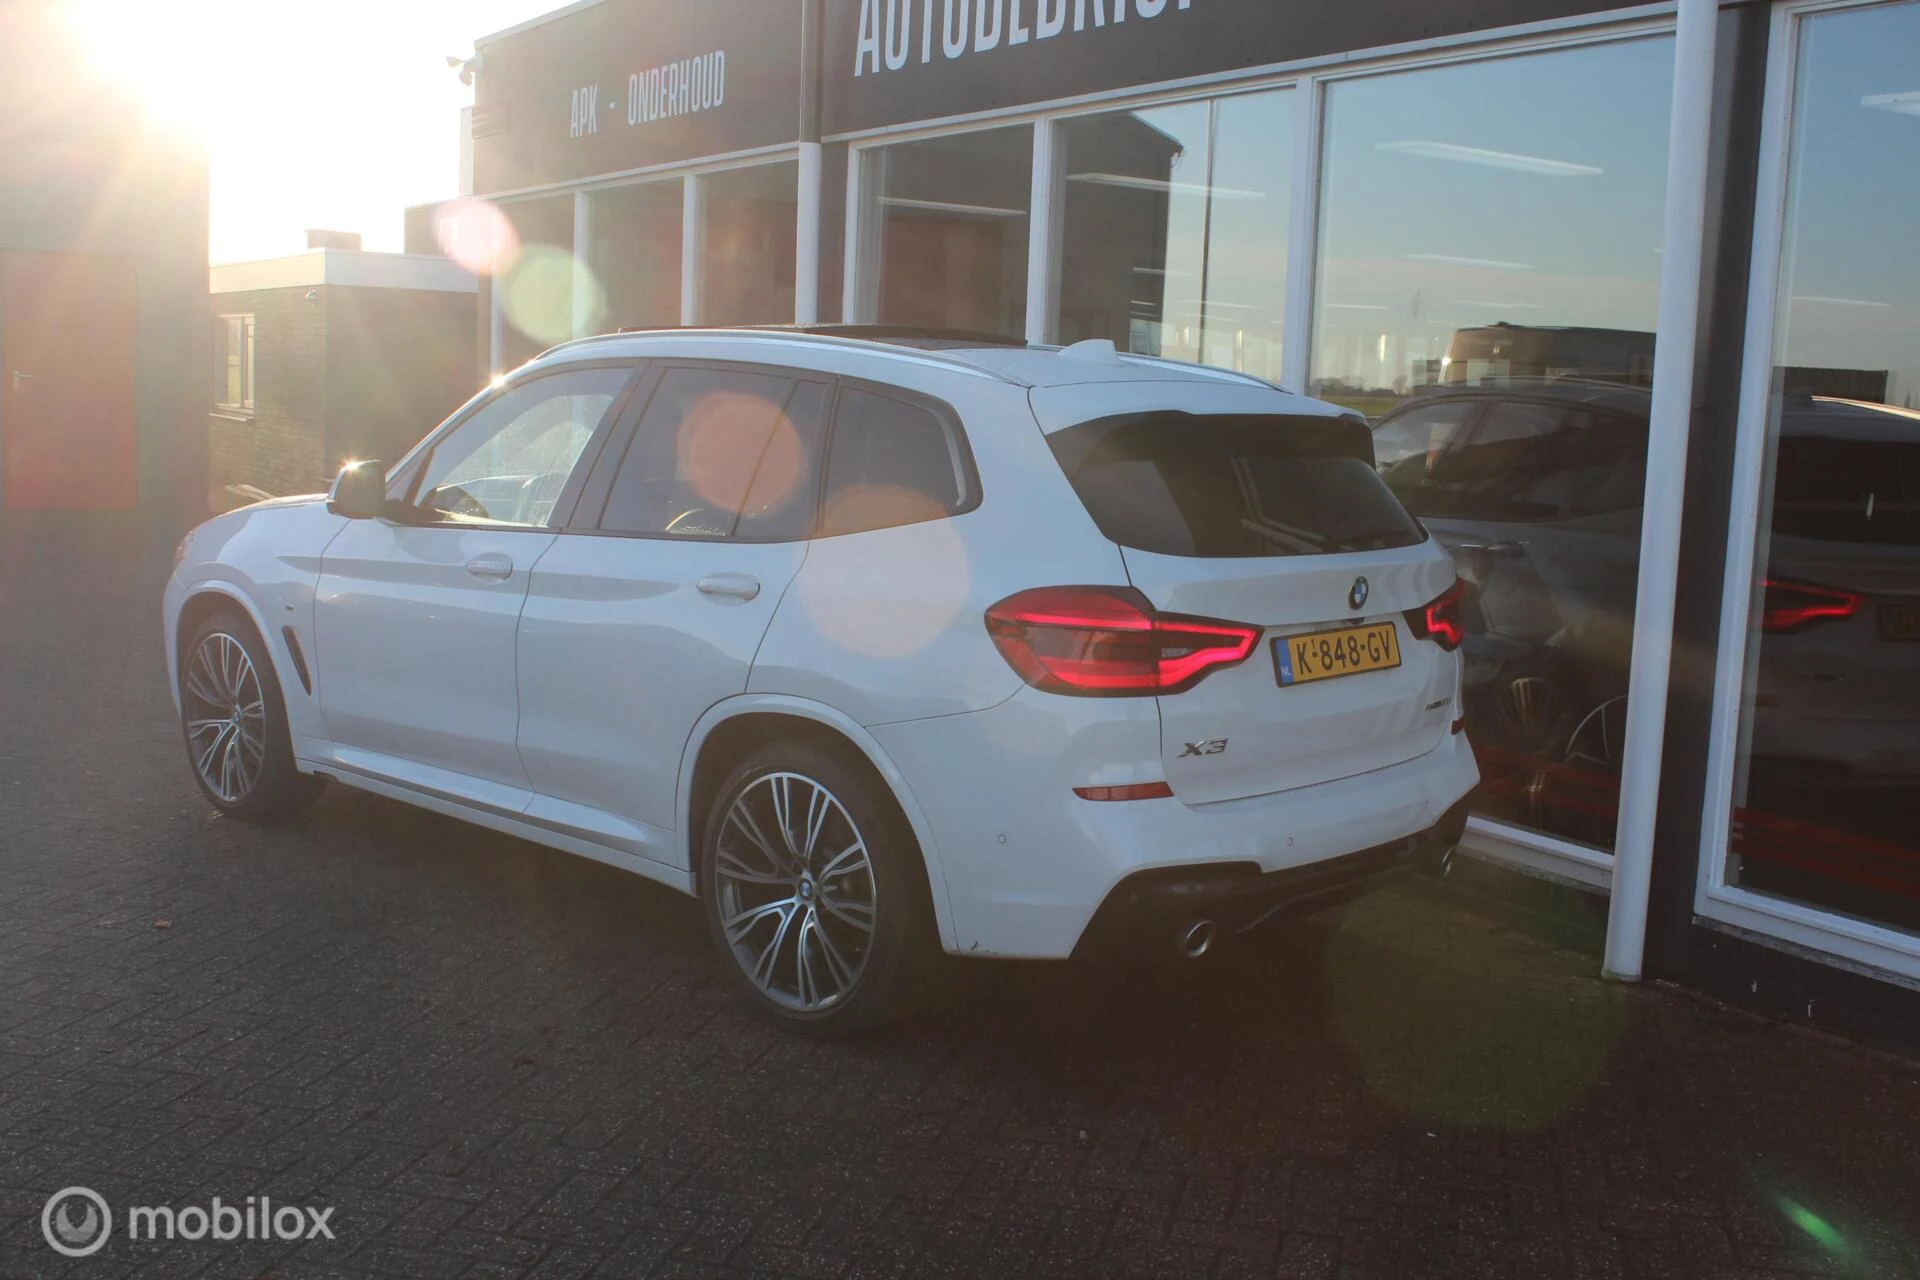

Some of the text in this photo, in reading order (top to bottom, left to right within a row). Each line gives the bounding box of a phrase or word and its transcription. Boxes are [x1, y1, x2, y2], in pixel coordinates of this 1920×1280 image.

[569, 84, 598, 138] APK
[627, 50, 725, 125] ONDERHOUD
[1296, 630, 1390, 675] K-848-GV
[1177, 738, 1229, 758] X3
